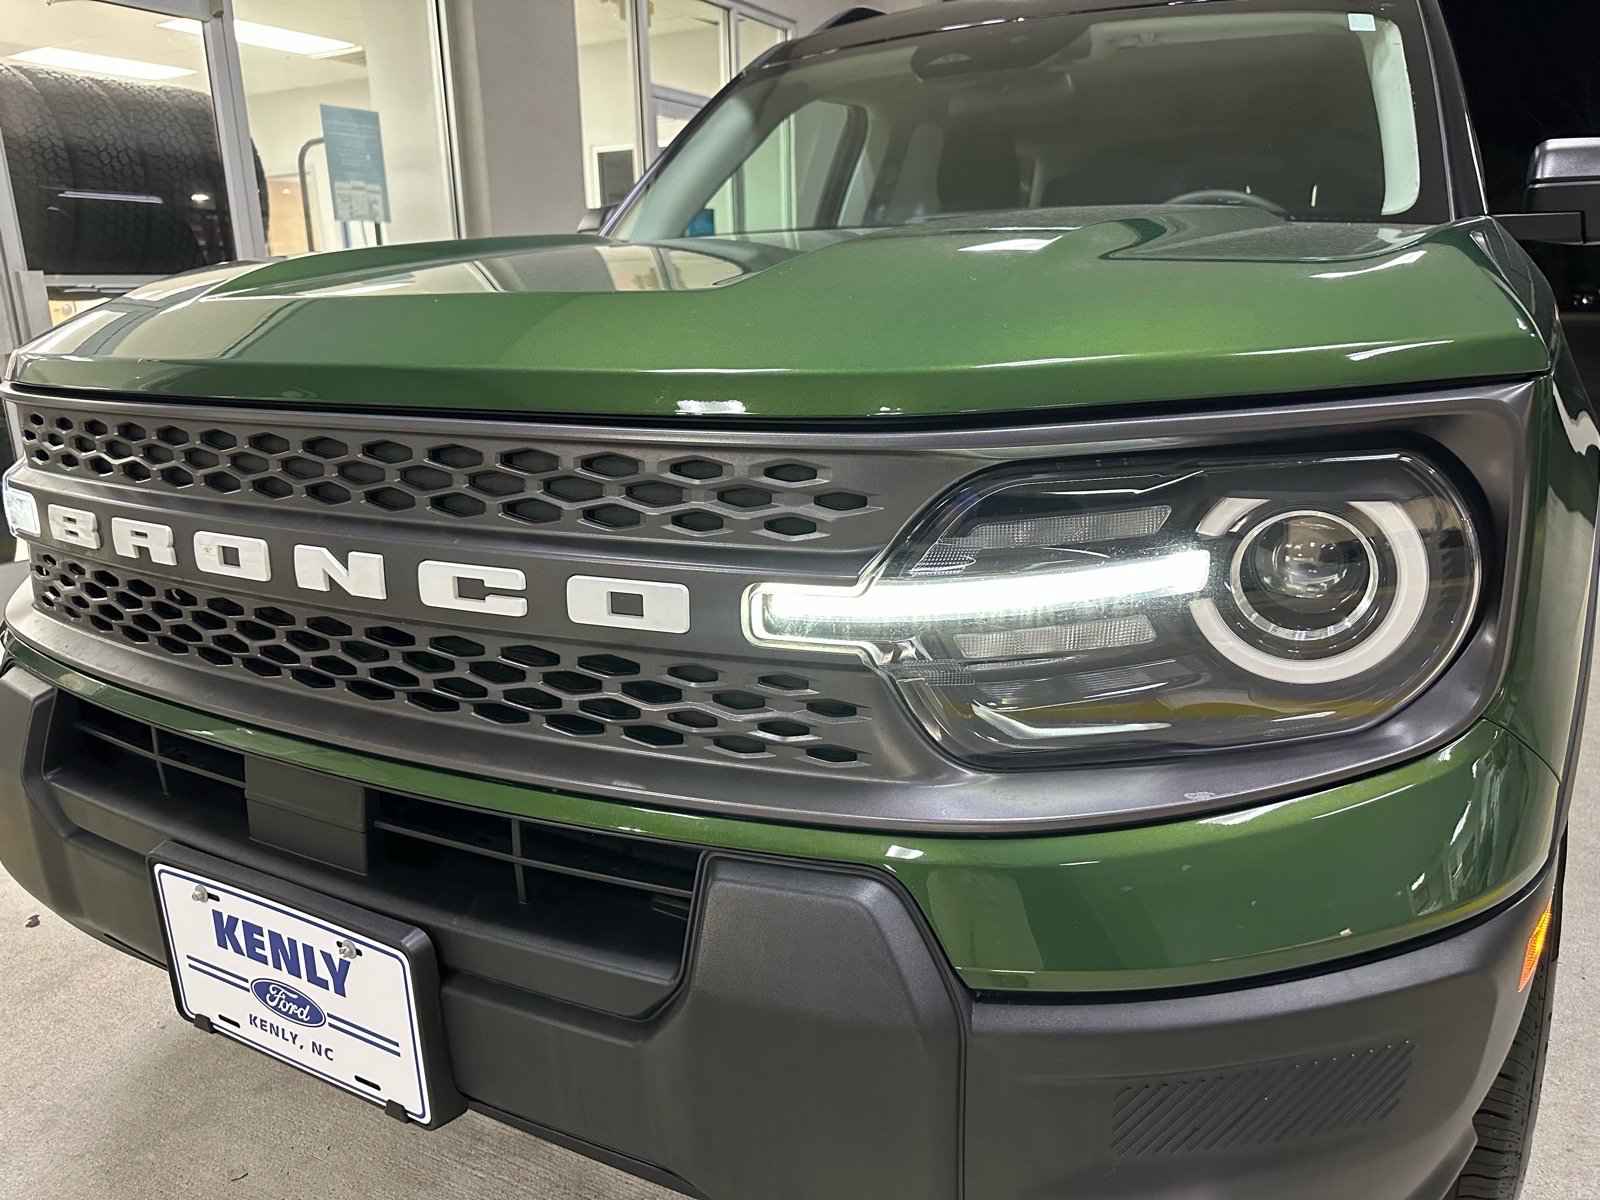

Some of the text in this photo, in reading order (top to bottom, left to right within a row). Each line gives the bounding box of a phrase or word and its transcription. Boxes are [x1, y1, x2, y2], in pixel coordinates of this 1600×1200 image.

[47, 503, 691, 634] BRONCO
[213, 910, 351, 998] KENLY
[265, 984, 310, 1022] Ford
[250, 1014, 334, 1061] KENLY, NC
